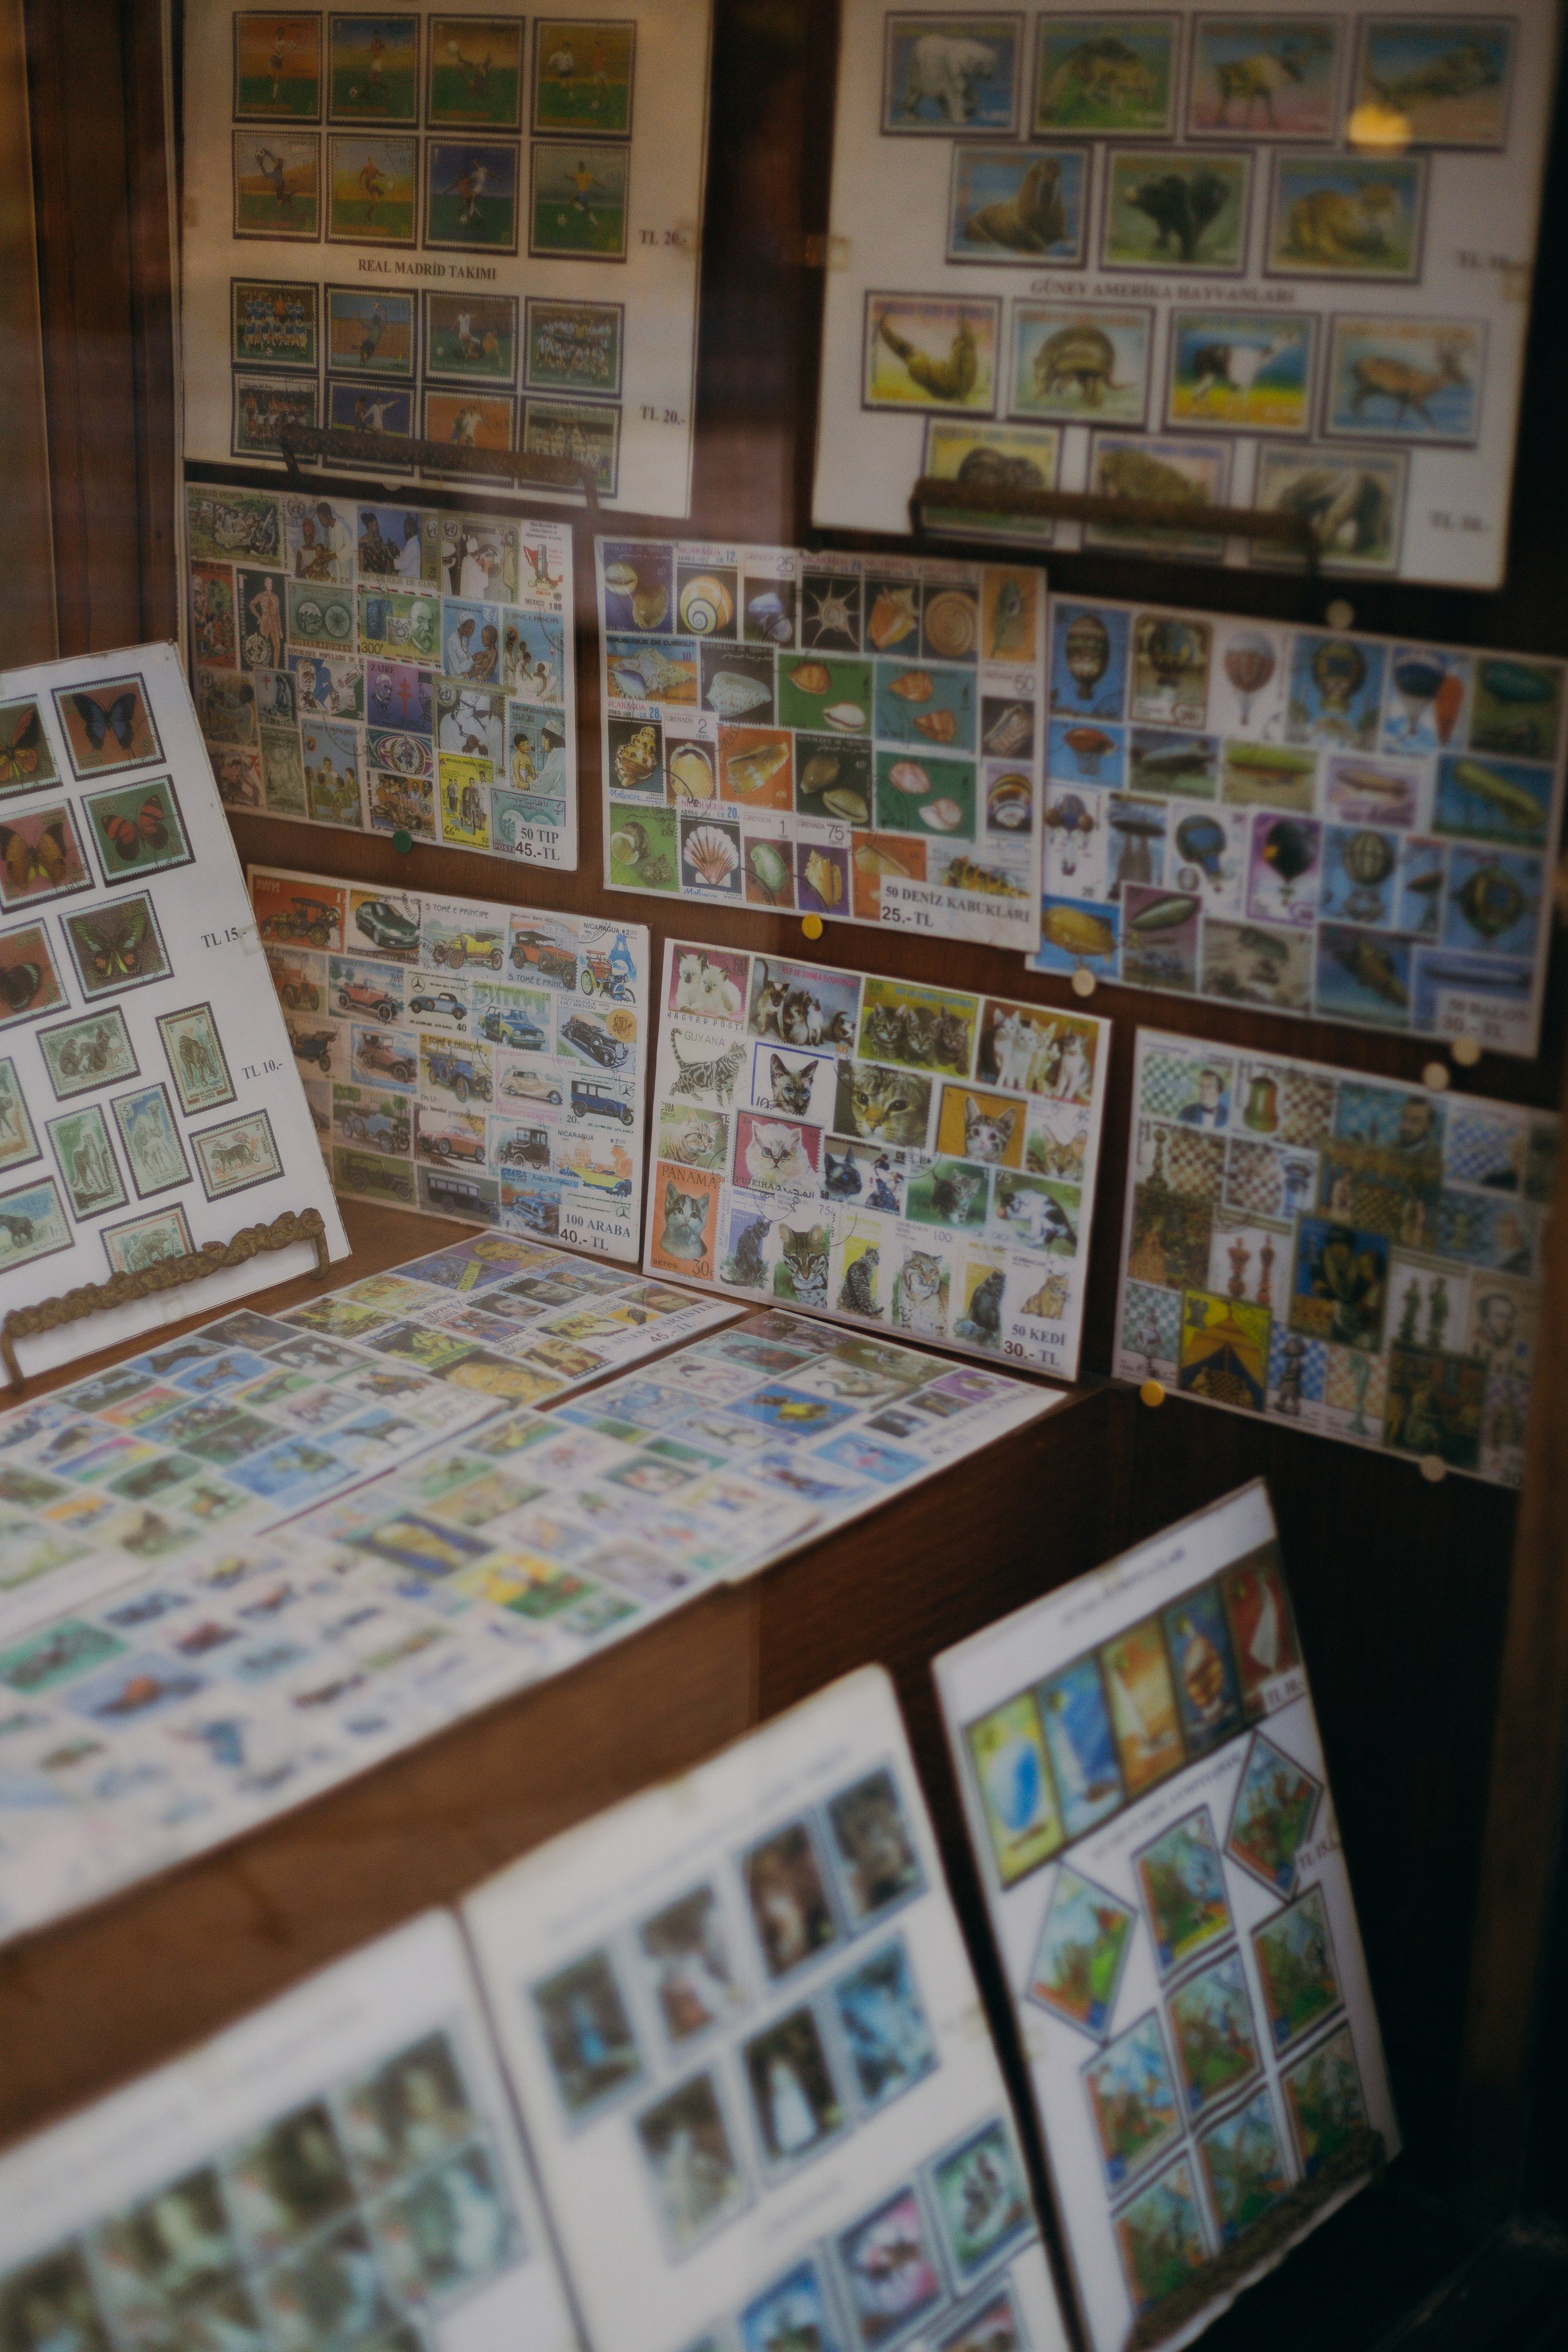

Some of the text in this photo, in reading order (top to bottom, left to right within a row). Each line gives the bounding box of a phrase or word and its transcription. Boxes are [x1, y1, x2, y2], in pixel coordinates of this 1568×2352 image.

[358, 258, 497, 281] REAL MADRİD TAKIMI
[640, 405, 659, 421] TL
[775, 556, 794, 572] 25
[524, 598, 545, 607] MEXICO
[650, 638, 662, 647] DE
[665, 715, 693, 724] GRENADA
[698, 718, 707, 734] 2
[680, 799, 725, 812] NICARAGUA
[744, 814, 772, 824] GRENADA
[797, 820, 826, 829] GRENADA
[779, 820, 785, 834] 1
[826, 824, 845, 841] 75
[521, 827, 560, 843] 50 TIP
[433, 903, 451, 914] TOMÉ
[459, 907, 489, 919] PRÍNCIPE
[885, 886, 1030, 922] 50 DENİZ KABUKLARI
[881, 906, 935, 927] 25.- TL
[583, 922, 620, 934] NICARAGUA
[200, 932, 222, 949] TL
[516, 974, 535, 984] TOMÉ
[794, 968, 801, 977] DE
[802, 969, 823, 981] GUINEA
[560, 996, 596, 1006] REPUBLIQUE
[573, 1002, 597, 1011] BENIN
[666, 1011, 709, 1025] MAGYAR
[456, 1022, 467, 1032] 40
[428, 1036, 446, 1046] TOMÉ
[684, 1030, 726, 1047] GUYANA
[241, 1058, 284, 1080] TL 10.-
[200, 1093, 216, 1102] CONGO
[566, 1114, 578, 1124] 20
[557, 1129, 595, 1141] NICARAGUA
[260, 1136, 270, 1155] CONGO
[661, 1164, 717, 1189] PANAMA
[735, 1176, 774, 1190] FUJEIRA
[565, 1213, 631, 1238] 100 ARABA
[718, 1212, 727, 1248] AFGHAN
[559, 1227, 609, 1251] 40.- TL
[652, 1257, 679, 1270] aereo
[611, 1324, 659, 1346] SİNEMA
[660, 1300, 723, 1327] ARTİSTLER
[1011, 1322, 1066, 1346] 50 KEDİ
[1003, 1340, 1060, 1366] 30.- TL
